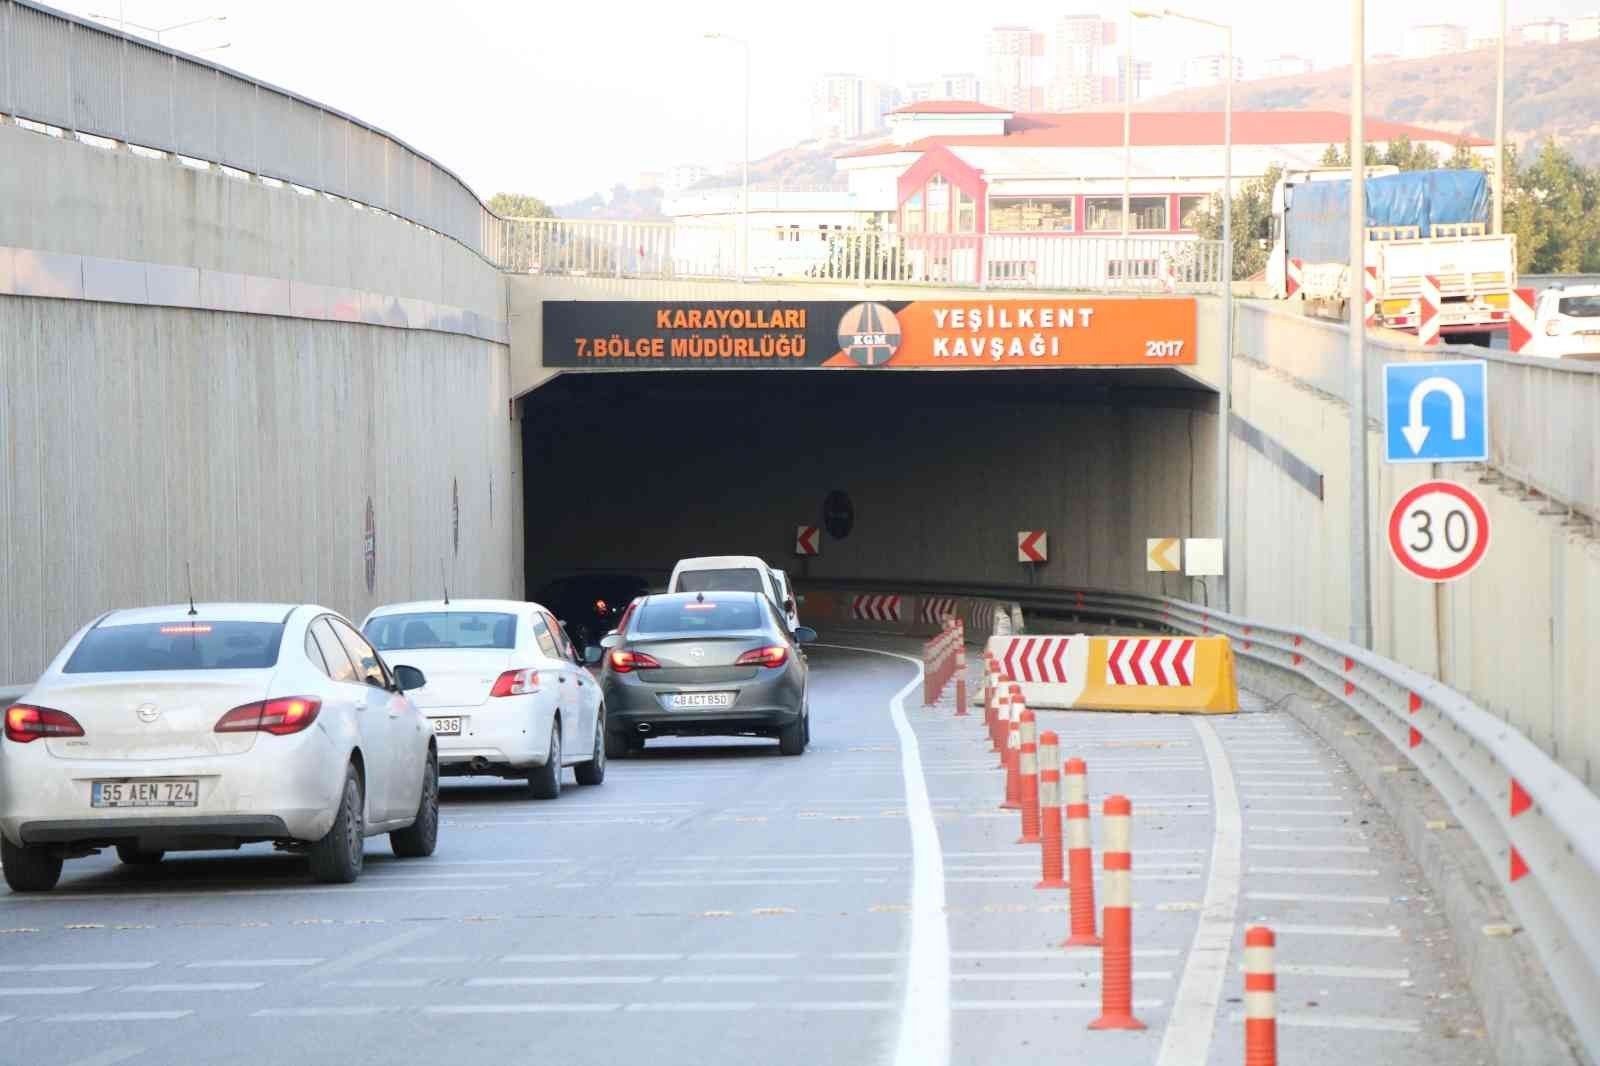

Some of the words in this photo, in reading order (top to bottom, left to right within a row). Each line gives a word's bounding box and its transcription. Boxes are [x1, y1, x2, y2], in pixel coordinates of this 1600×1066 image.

[656, 309, 806, 328] KARAYOLLARI
[933, 305, 1094, 332] YEŞİLKENT
[575, 333, 665, 358] 7.BÖLGE
[671, 333, 806, 358] MÜDÜRLÜĞÜ
[852, 335, 886, 345] KGM
[933, 334, 1060, 361] KAVŞAĞI
[1144, 340, 1184, 356] 2017
[1410, 509, 1469, 552] 30
[435, 719, 458, 731] 336
[103, 784, 123, 801] 55
[129, 783, 159, 801] AEN
[165, 783, 192, 800] 724
